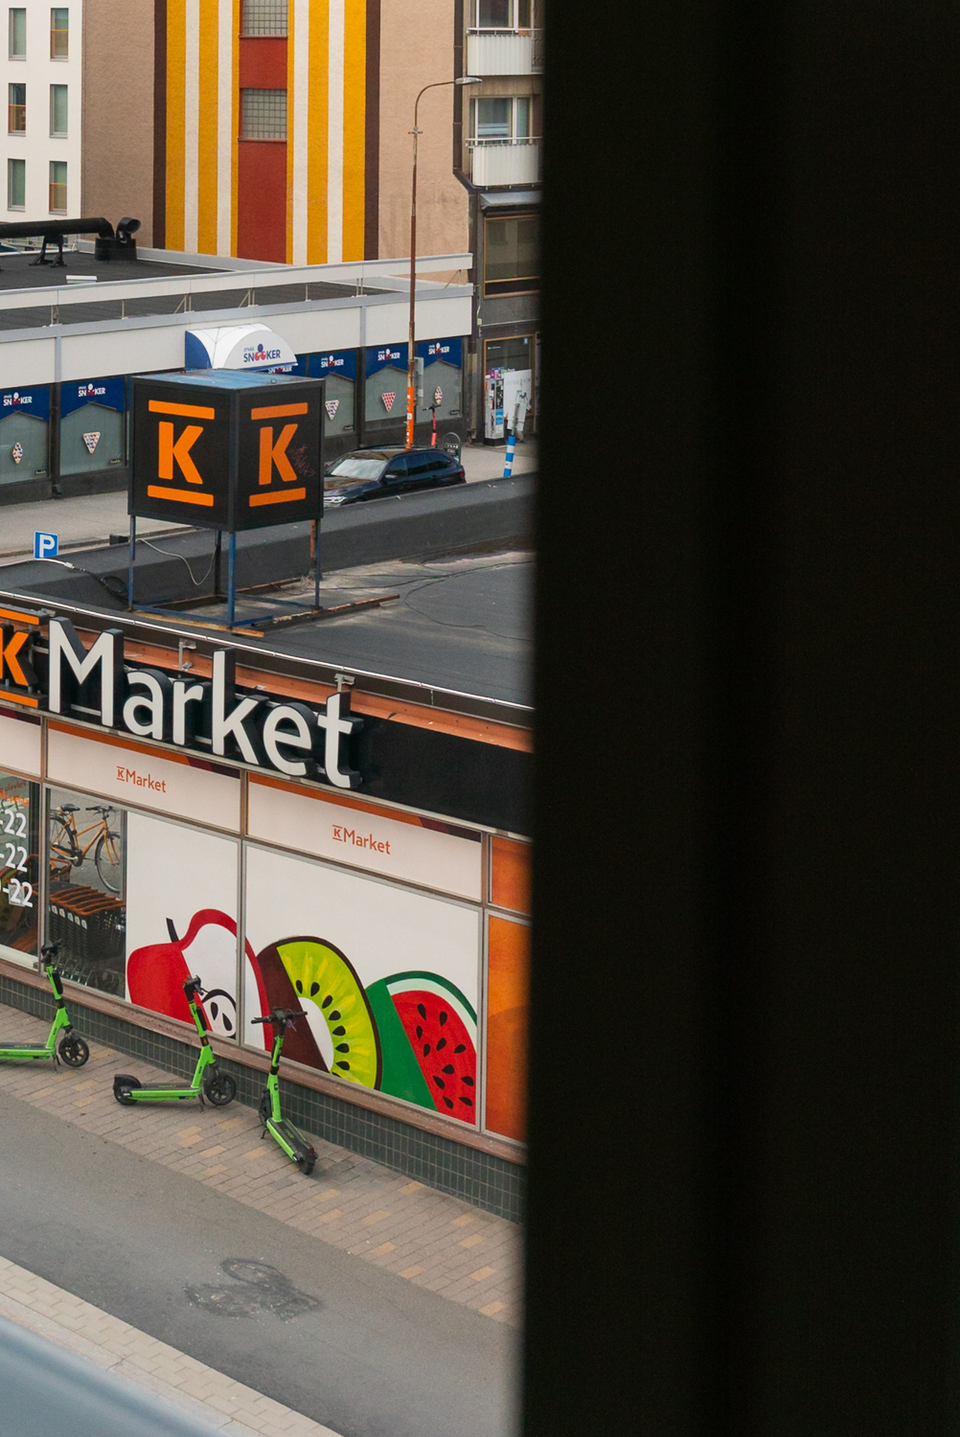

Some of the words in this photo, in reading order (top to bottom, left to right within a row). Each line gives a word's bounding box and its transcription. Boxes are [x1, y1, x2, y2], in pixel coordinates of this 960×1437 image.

[243, 349, 281, 362] SNOOKER
[3, 396, 32, 406] SNOOKER
[158, 421, 204, 484] K
[258, 423, 298, 485] K
[39, 534, 55, 558] P
[48, 616, 354, 789] Market
